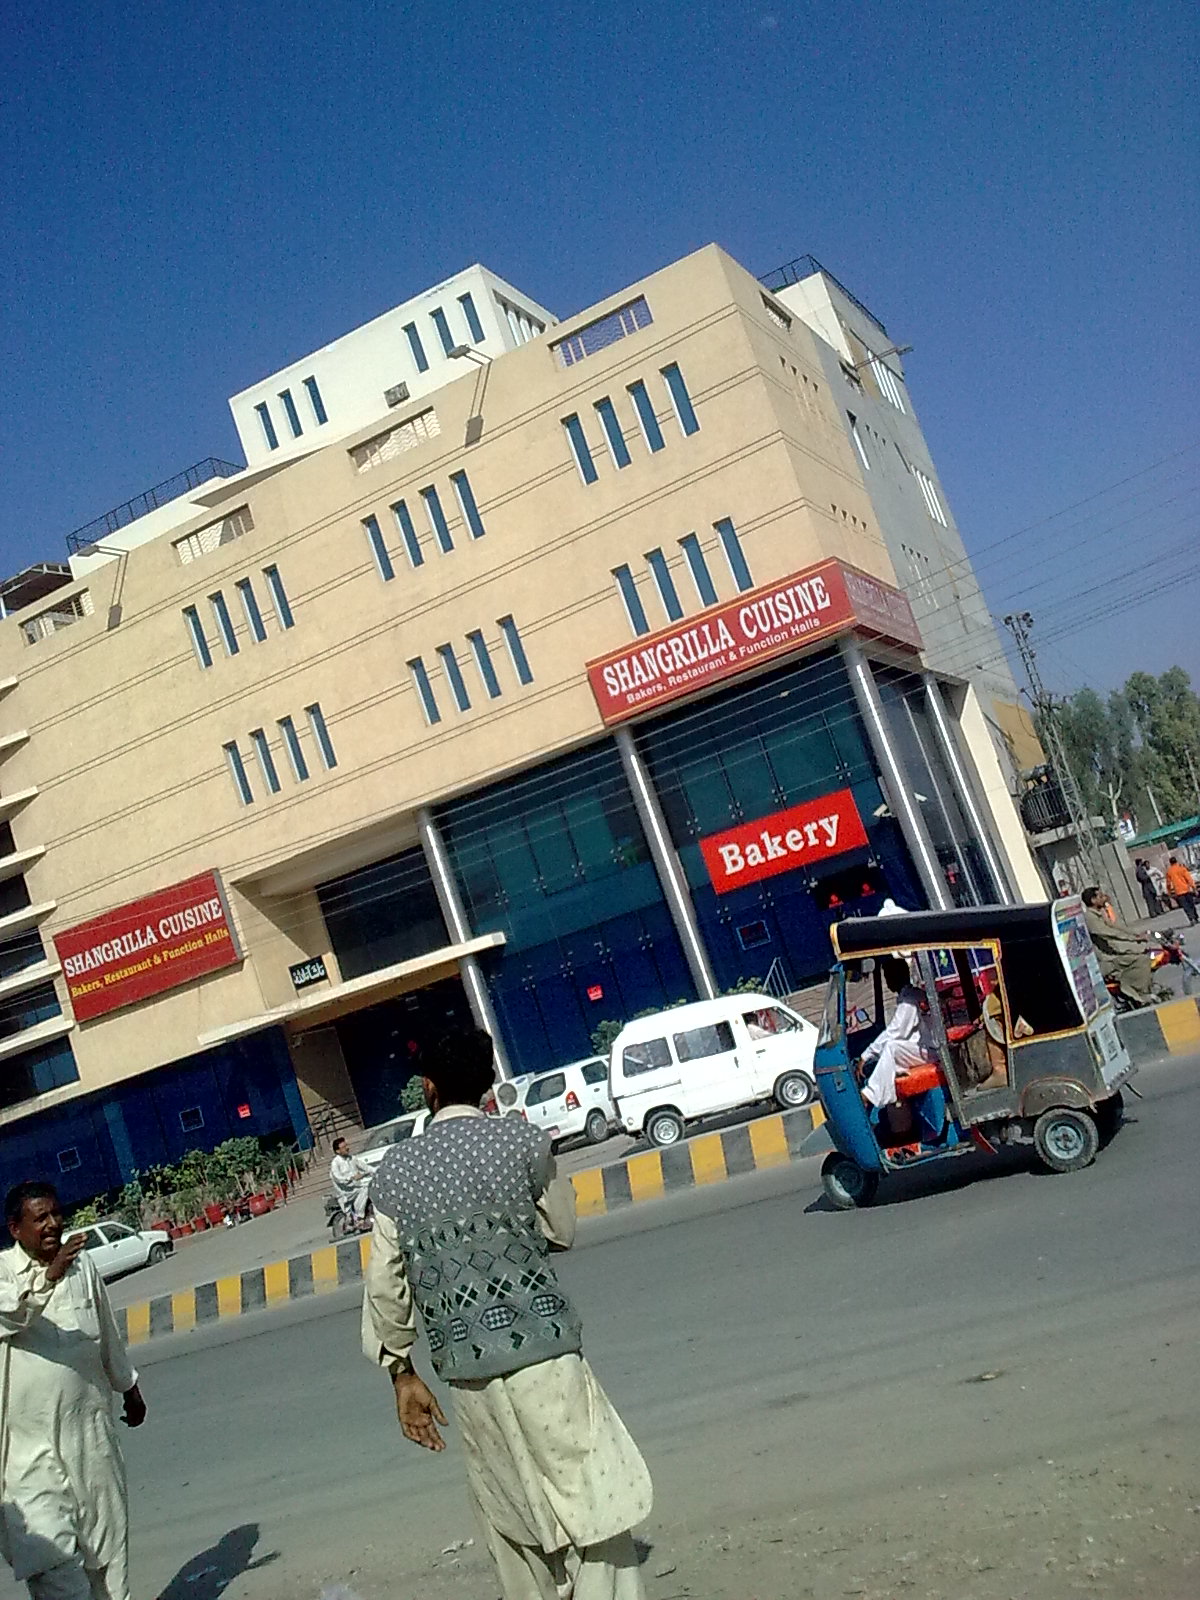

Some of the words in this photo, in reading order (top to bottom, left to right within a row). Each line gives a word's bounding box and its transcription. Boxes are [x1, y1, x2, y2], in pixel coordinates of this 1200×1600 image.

[602, 618, 736, 697] SHANGRILLA
[739, 576, 831, 639] CUISINE
[667, 655, 727, 687] Restaurant
[728, 650, 738, 661] &
[738, 630, 789, 658] Function
[789, 618, 821, 637] Halls
[718, 814, 840, 876] Bakery
[63, 924, 159, 978] SHANGRILLA
[158, 897, 223, 939] CUISINE
[104, 957, 153, 986] Restaurant
[153, 953, 162, 965] &
[162, 939, 204, 962] Function
[204, 927, 229, 945] Halls
